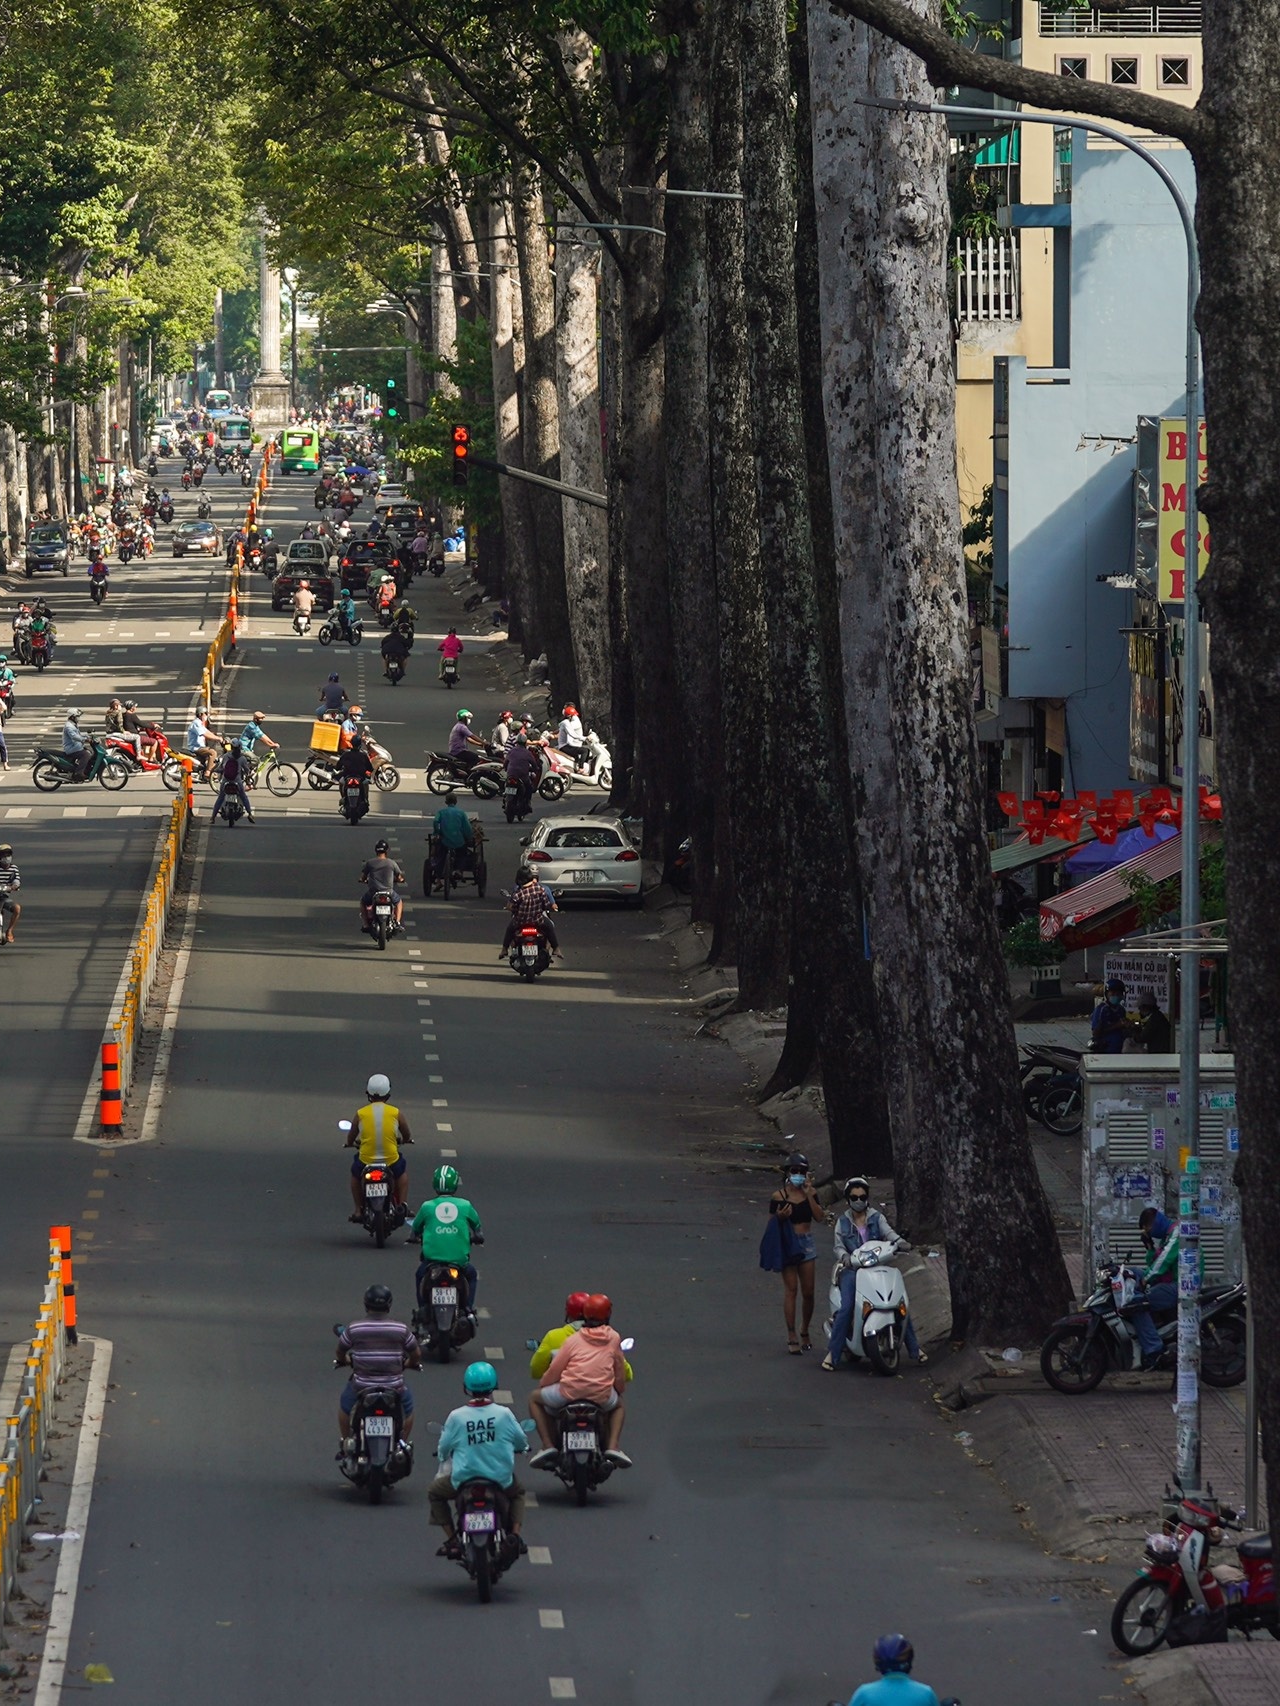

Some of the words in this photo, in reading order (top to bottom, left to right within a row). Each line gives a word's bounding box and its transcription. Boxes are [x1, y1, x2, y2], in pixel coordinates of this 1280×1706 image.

[1106, 959, 1122, 970] BÚN
[1124, 958, 1142, 971] MẮM
[1144, 961, 1154, 972] CÔ
[1157, 963, 1167, 972] BA
[435, 1225, 458, 1234] Grab
[466, 1416, 496, 1433] BAE
[467, 1430, 496, 1446] MIN
